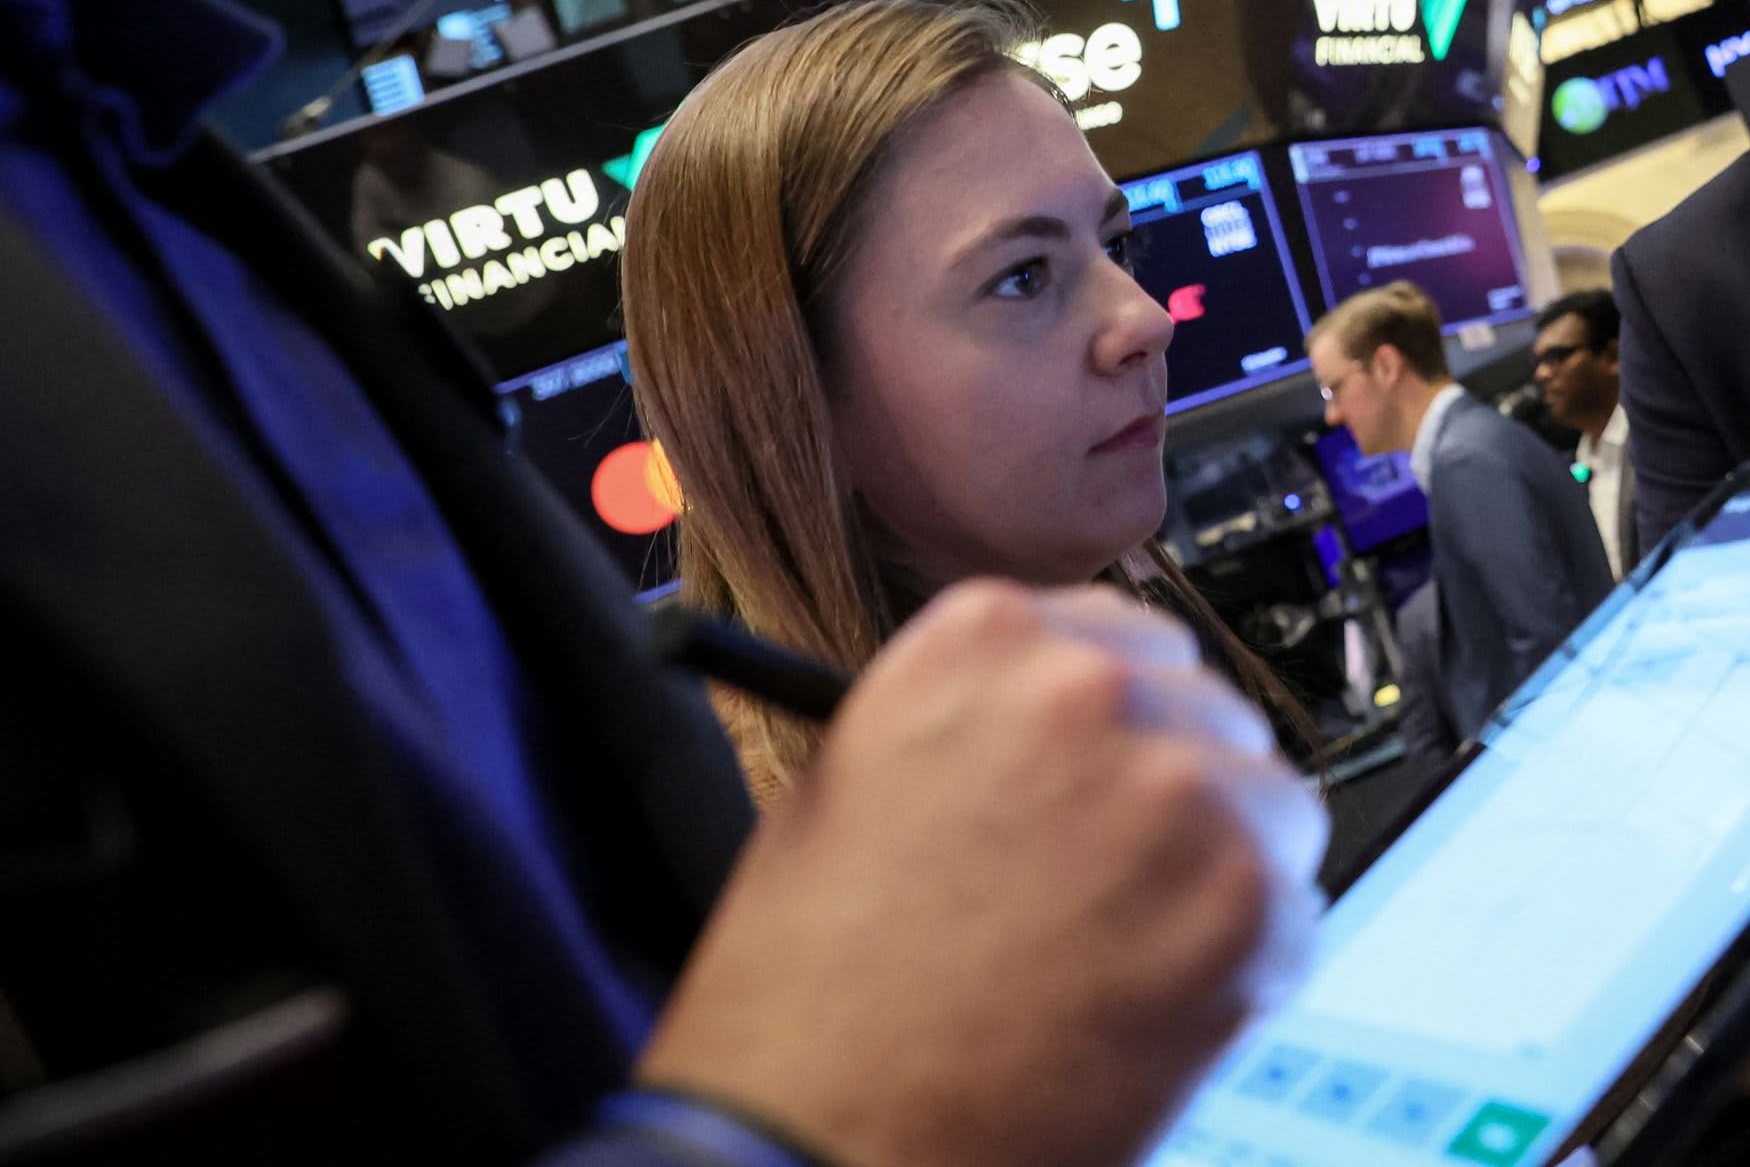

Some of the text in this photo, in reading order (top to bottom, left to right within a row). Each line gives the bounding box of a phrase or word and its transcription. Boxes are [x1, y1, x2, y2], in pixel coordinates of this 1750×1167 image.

[1012, 21, 1143, 102] se
[1315, 34, 1426, 67] FINANCIAL
[367, 168, 599, 278] VIRTU
